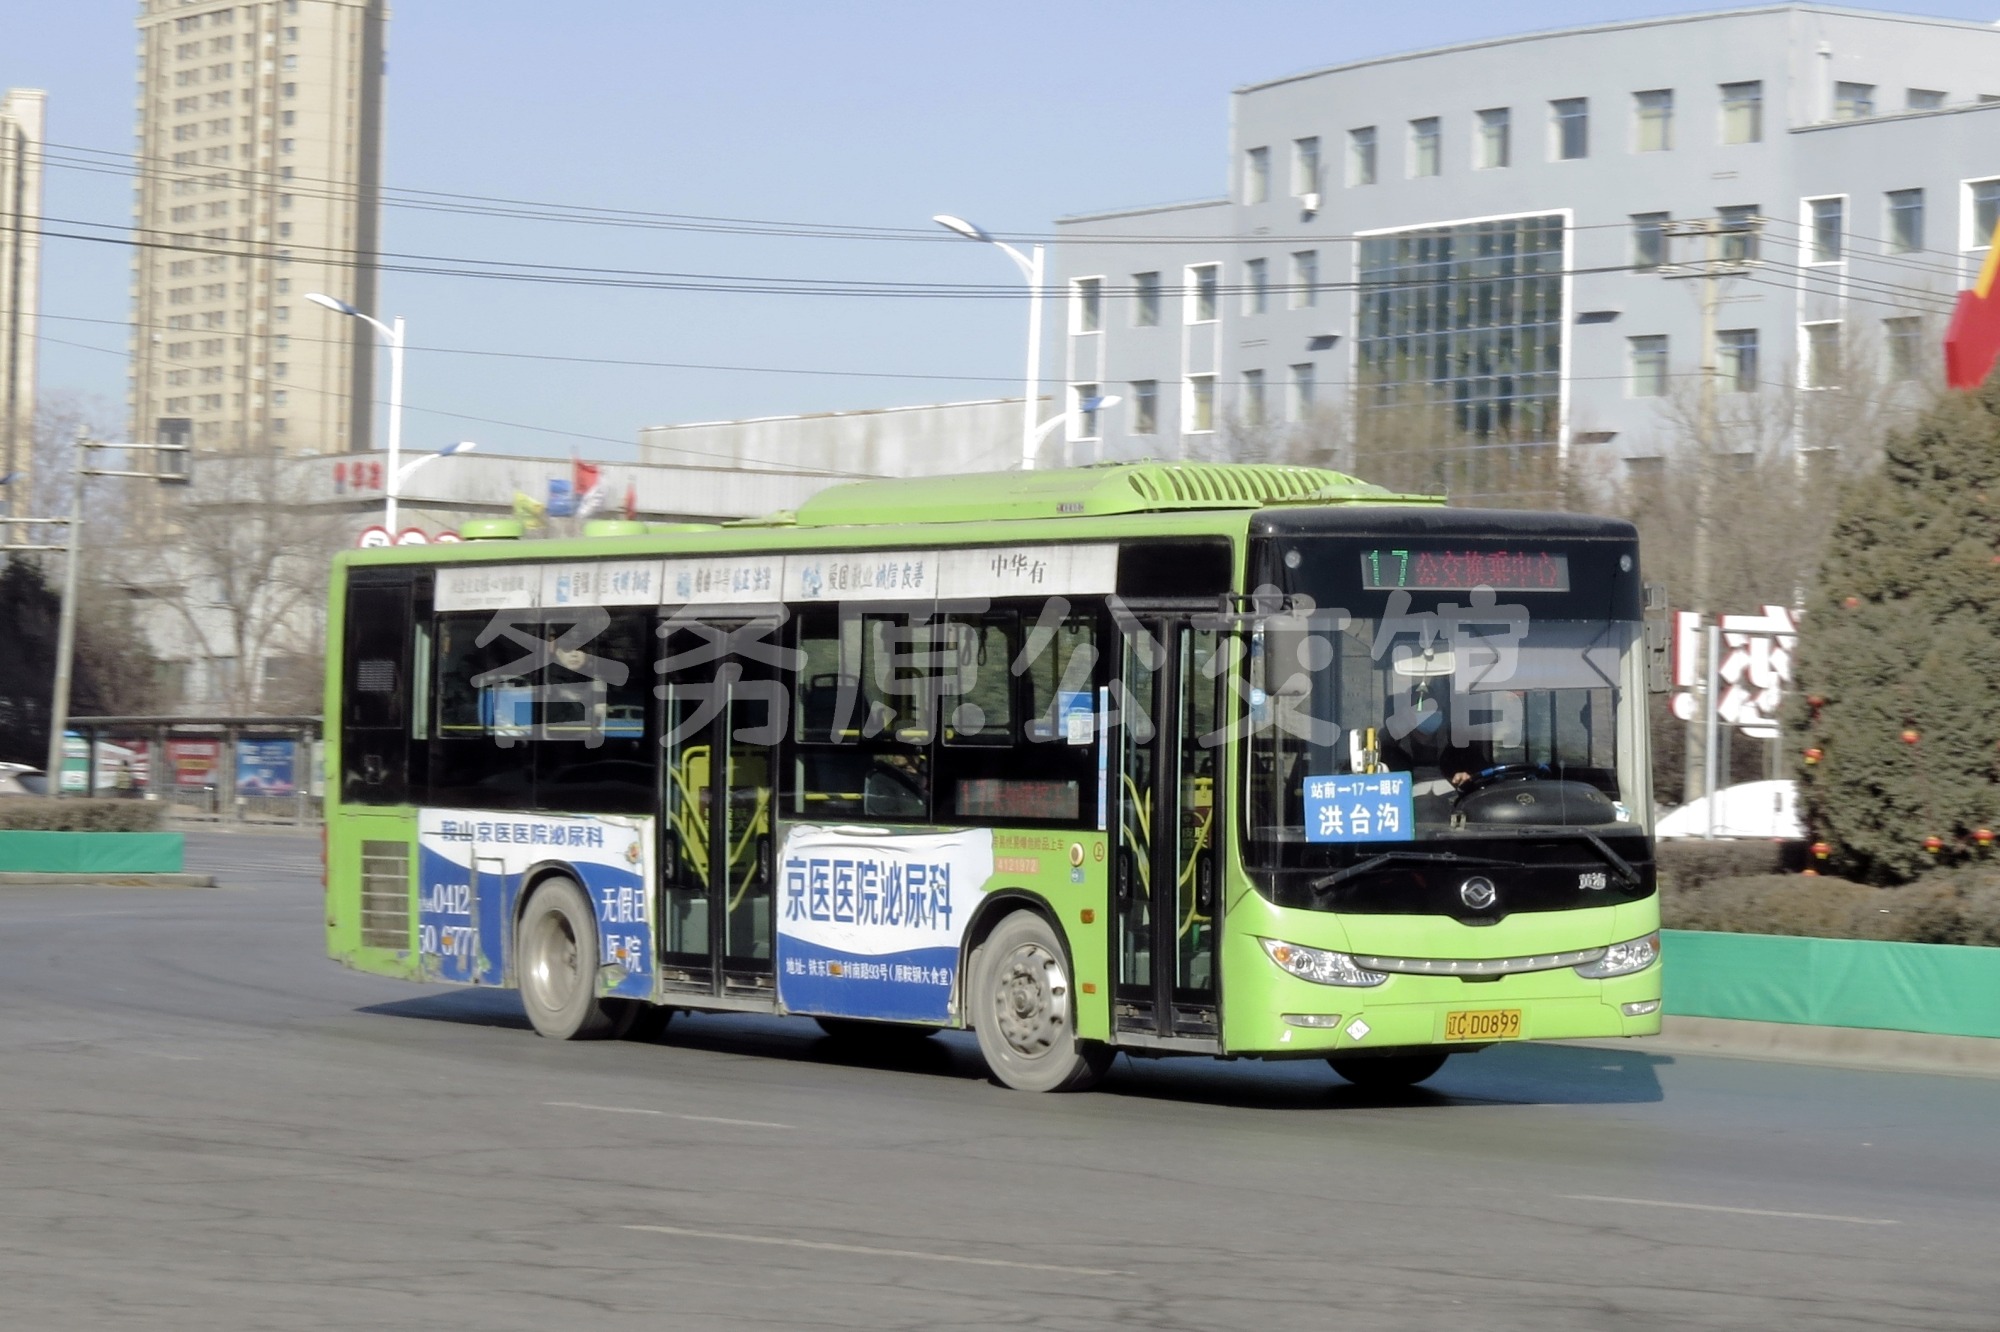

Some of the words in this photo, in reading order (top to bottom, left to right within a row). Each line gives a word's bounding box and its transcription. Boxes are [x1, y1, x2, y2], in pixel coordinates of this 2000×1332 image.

[1368, 549, 1408, 587] 17
[441, 820, 604, 848] 鞍山京医医院泌尿科
[1318, 803, 1400, 836] 洪台沟
[601, 886, 647, 923] 无假日
[785, 856, 953, 931] 京医医院泌尿科
[606, 934, 643, 973] 医院
